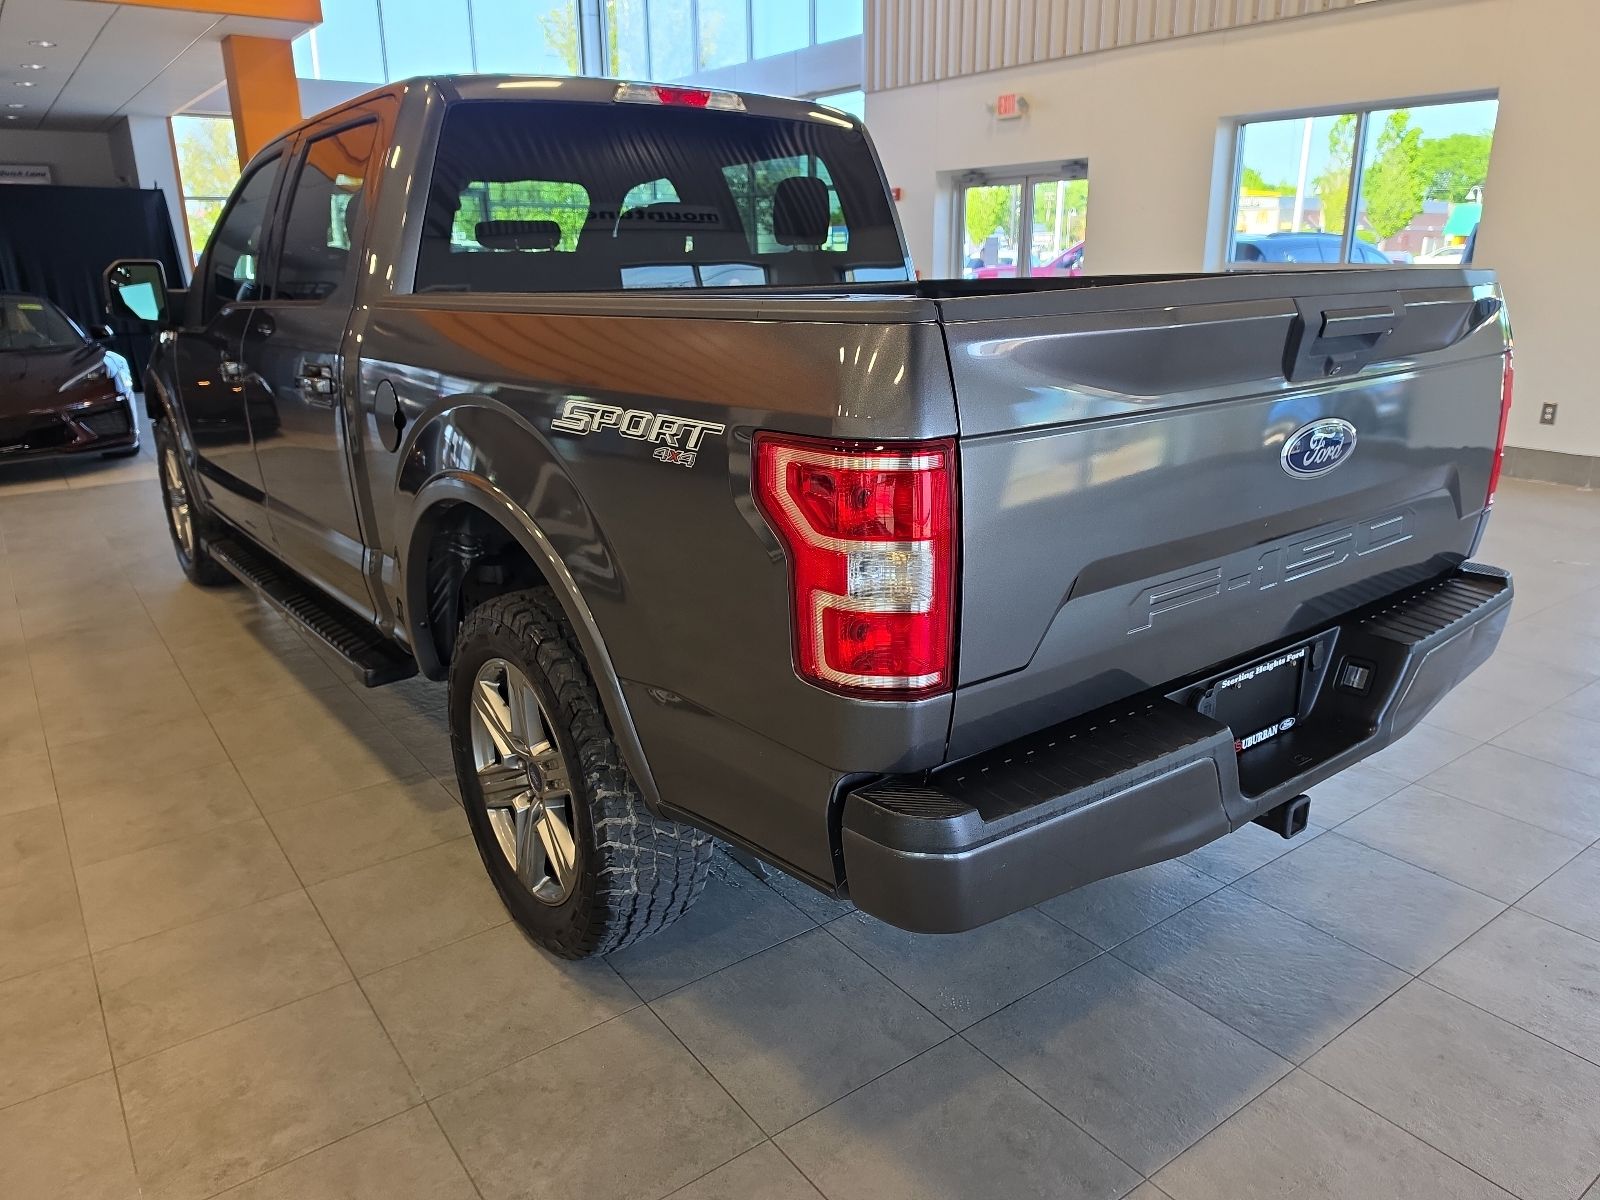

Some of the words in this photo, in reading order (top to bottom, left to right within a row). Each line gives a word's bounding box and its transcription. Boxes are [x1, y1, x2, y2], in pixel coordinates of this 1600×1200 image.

[551, 400, 726, 451] SPORT
[1302, 430, 1345, 467] Ford
[1127, 507, 1416, 636] F-150
[1221, 670, 1255, 689] Sterling
[1255, 658, 1286, 675] Heights
[1286, 648, 1305, 662] Ford
[1234, 723, 1279, 752] SUBURBAN
